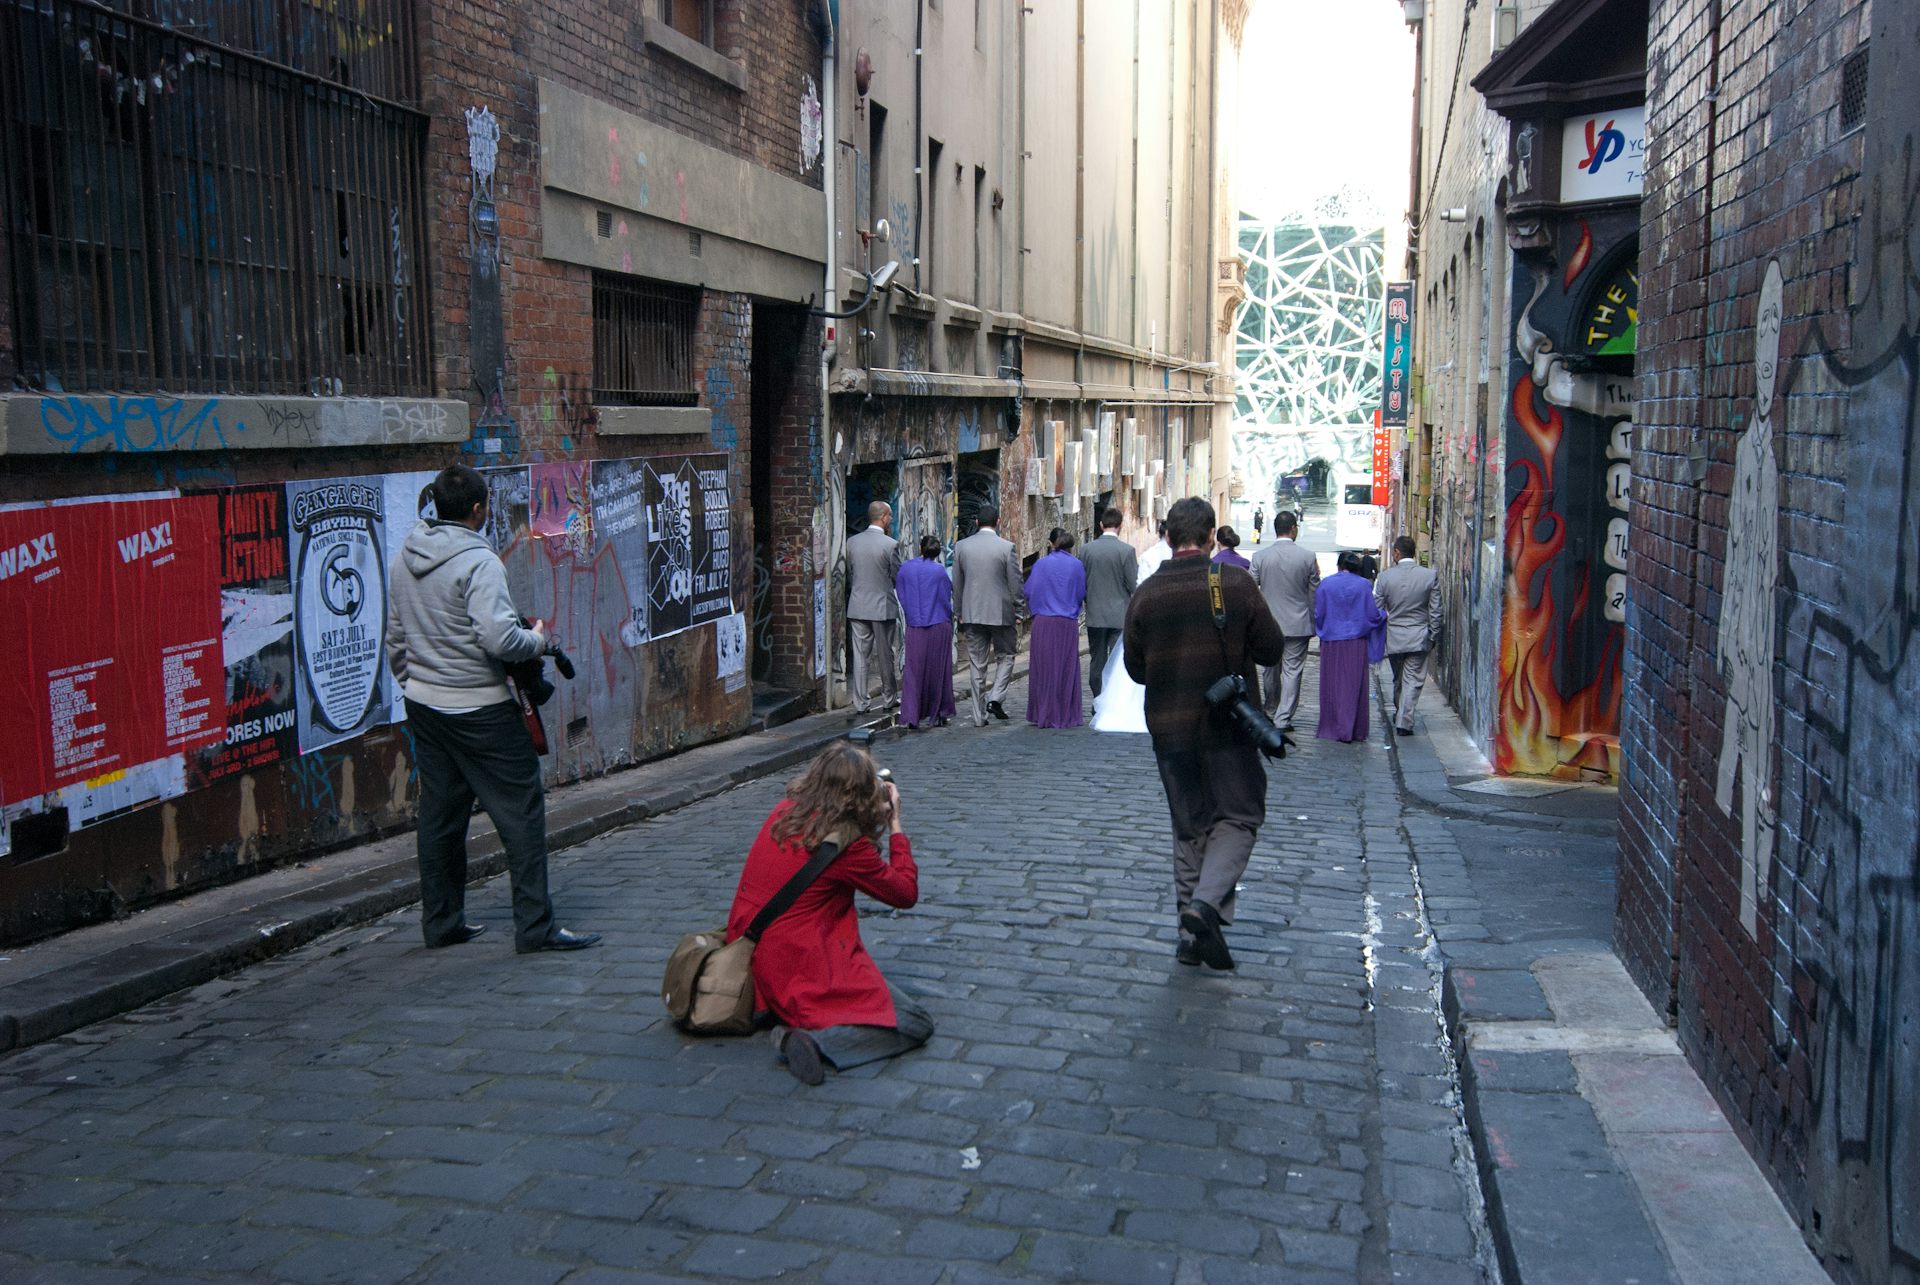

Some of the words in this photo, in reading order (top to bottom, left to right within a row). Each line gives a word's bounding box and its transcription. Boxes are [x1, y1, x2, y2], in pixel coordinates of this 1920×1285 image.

[1587, 283, 1628, 346] THE
[1389, 298, 1409, 412] MISTY
[1375, 427, 1384, 488] MOVIDA
[700, 470, 727, 490] STEPHAN
[660, 473, 691, 510] The
[704, 489, 729, 510] BODZIN
[225, 491, 278, 541] AMITY
[292, 485, 350, 530] GANGA
[311, 516, 367, 536] BAYAMI
[646, 504, 691, 543] Likes
[704, 510, 729, 531] ROBERT
[118, 521, 173, 564] WAX!
[713, 530, 729, 550] HOOD
[0, 532, 57, 581] WAX!
[152, 552, 175, 568] FRIDAYS
[221, 536, 283, 584] ICTION
[712, 550, 729, 570] HUGO
[34, 566, 61, 584] FRIDAYS
[694, 575, 706, 594] FRI
[706, 573, 723, 592] JULY
[722, 571, 729, 587] 2
[321, 629, 338, 649] SAT
[340, 628, 345, 645] 3
[346, 623, 366, 644] JULY
[312, 652, 327, 665] EAST
[74, 671, 97, 683] FROST
[74, 697, 88, 707] DAY
[81, 702, 97, 713] FOX
[264, 709, 295, 734] NOW
[242, 743, 257, 756] THE
